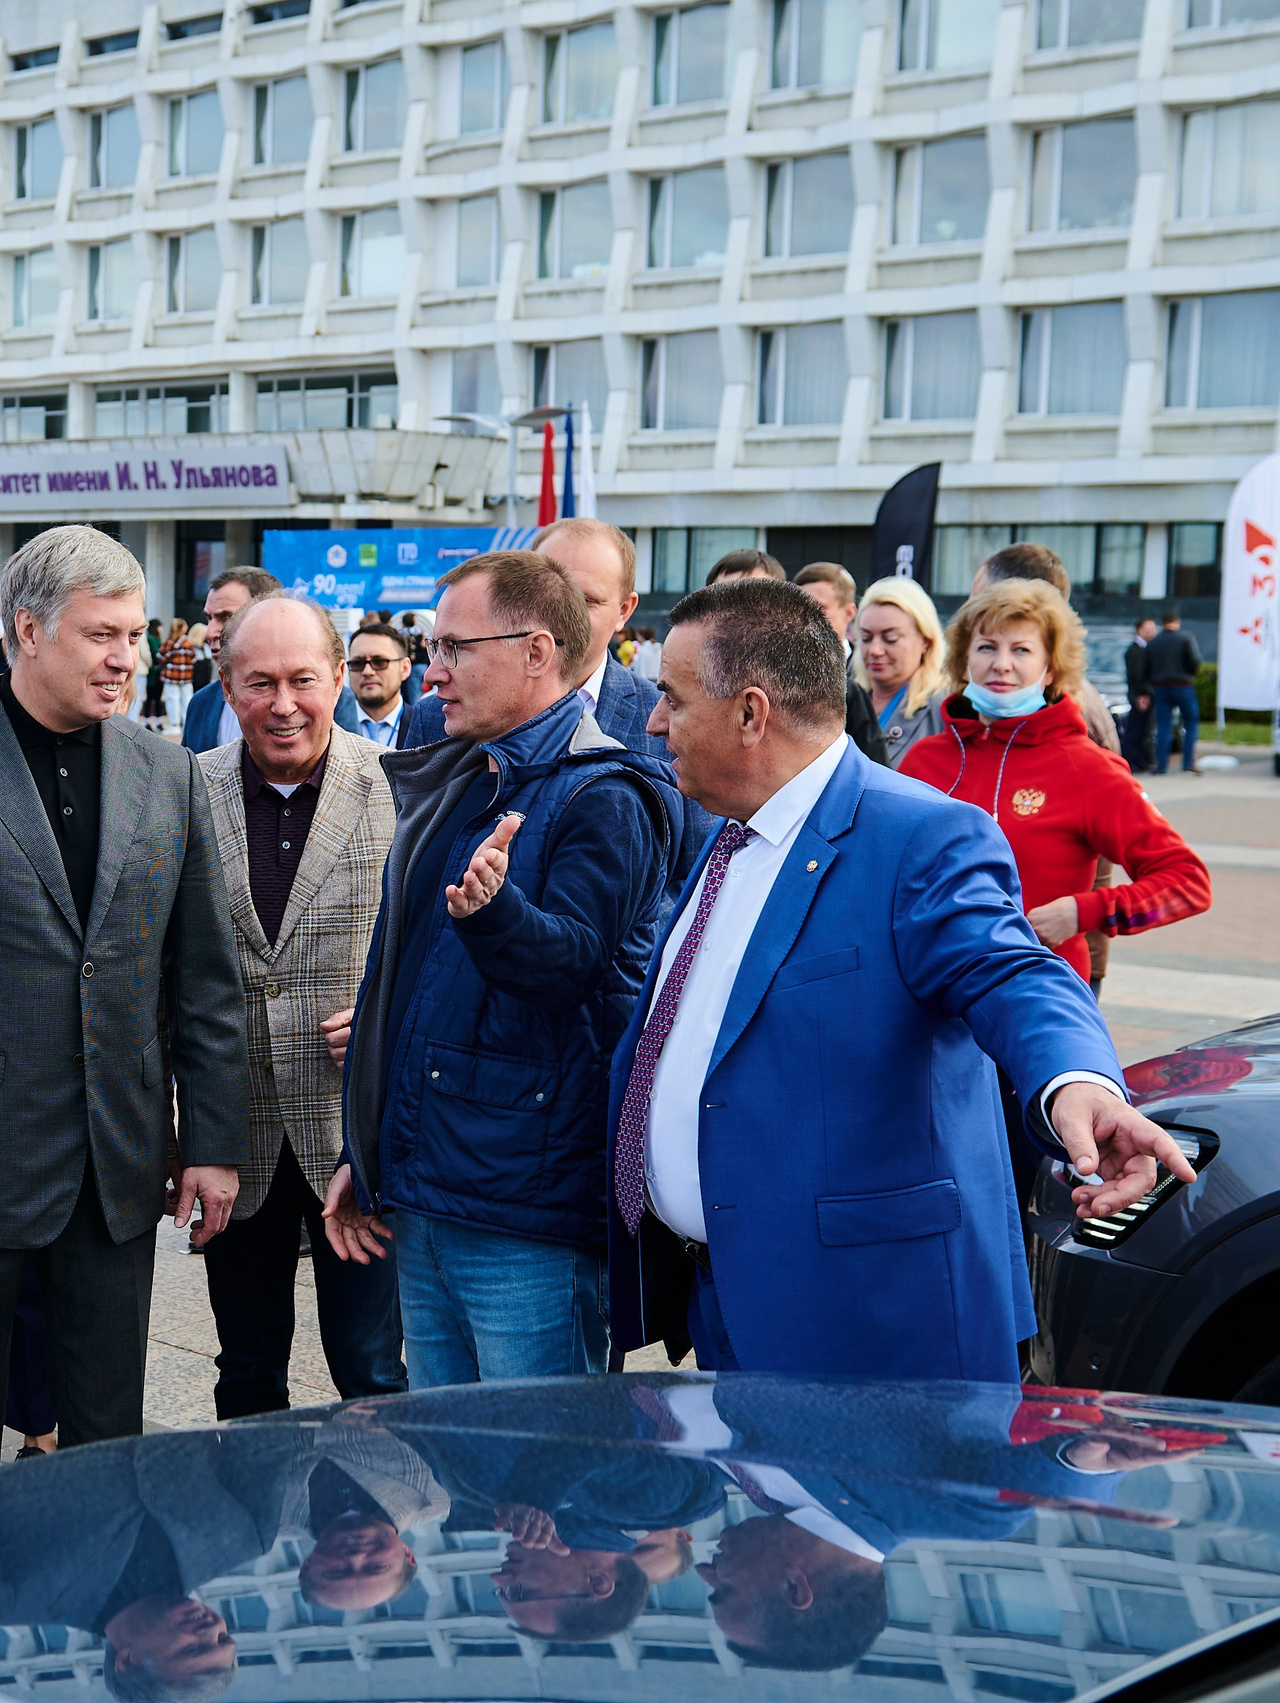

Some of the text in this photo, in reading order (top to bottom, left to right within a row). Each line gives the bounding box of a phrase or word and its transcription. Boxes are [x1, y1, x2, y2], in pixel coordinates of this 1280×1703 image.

[47, 469, 109, 492] имени
[115, 461, 138, 490] И.
[144, 460, 166, 490] Н.
[170, 458, 278, 489] Ульянова
[313, 573, 336, 596] 90
